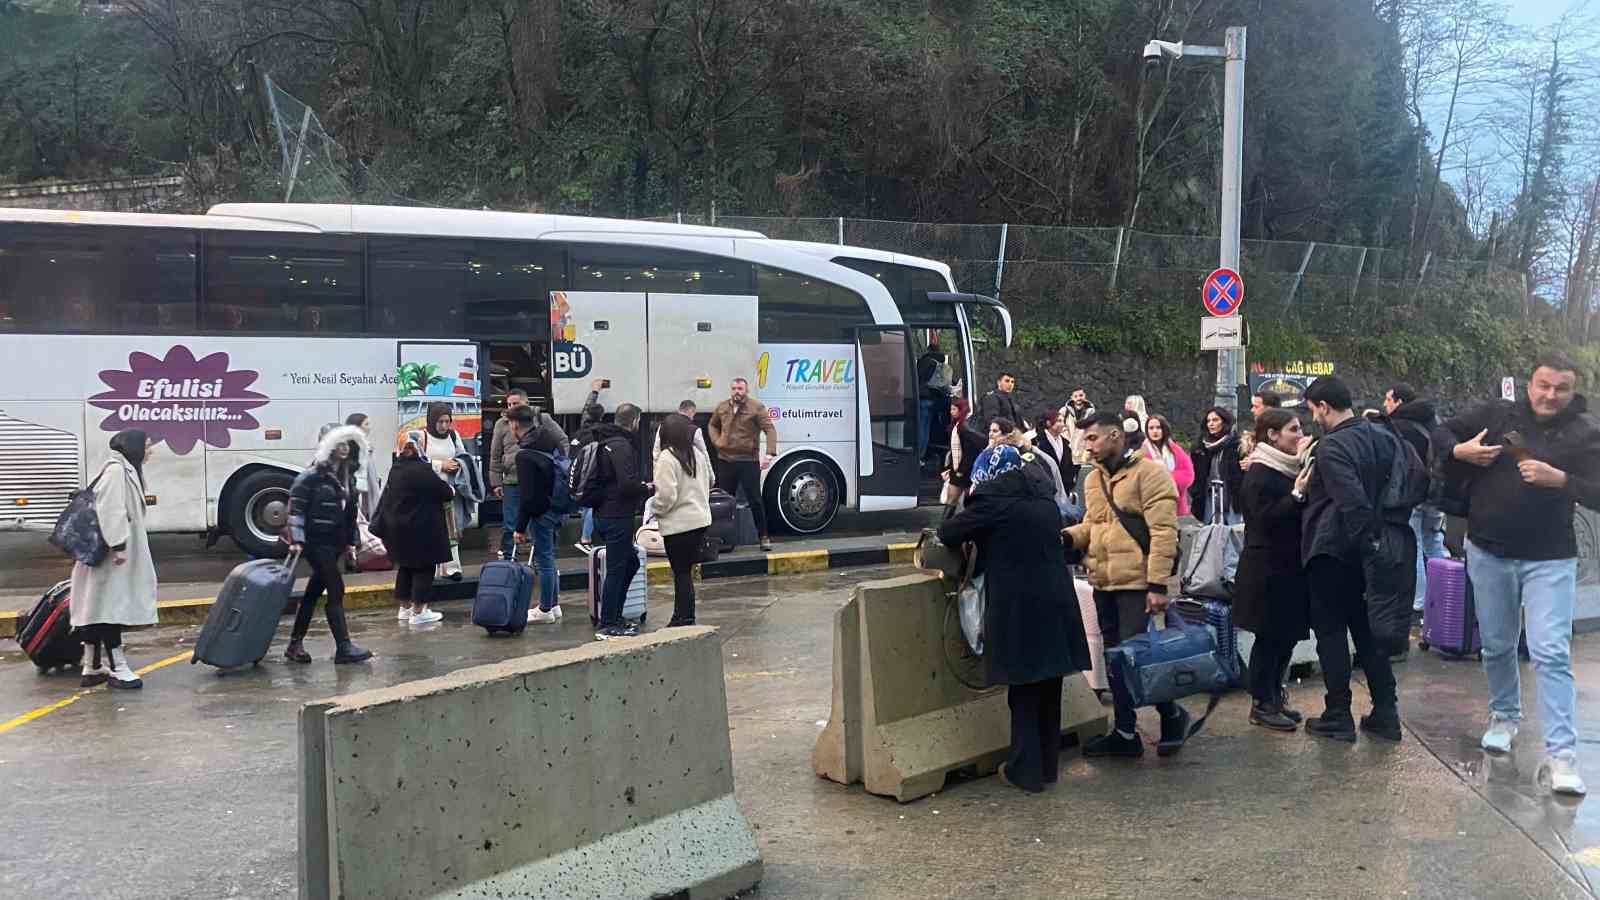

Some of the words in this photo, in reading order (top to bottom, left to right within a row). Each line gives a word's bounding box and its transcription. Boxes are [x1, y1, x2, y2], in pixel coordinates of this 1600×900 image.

[555, 346, 586, 373] BÜ
[1305, 361, 1334, 375] KEBAP
[290, 372, 310, 384] Yeni
[313, 373, 337, 385] Nesil
[339, 372, 377, 386] Seyahat
[786, 358, 855, 383] TRAVEL
[136, 378, 224, 403] Efulisi
[782, 409, 844, 419] efulimtravel
